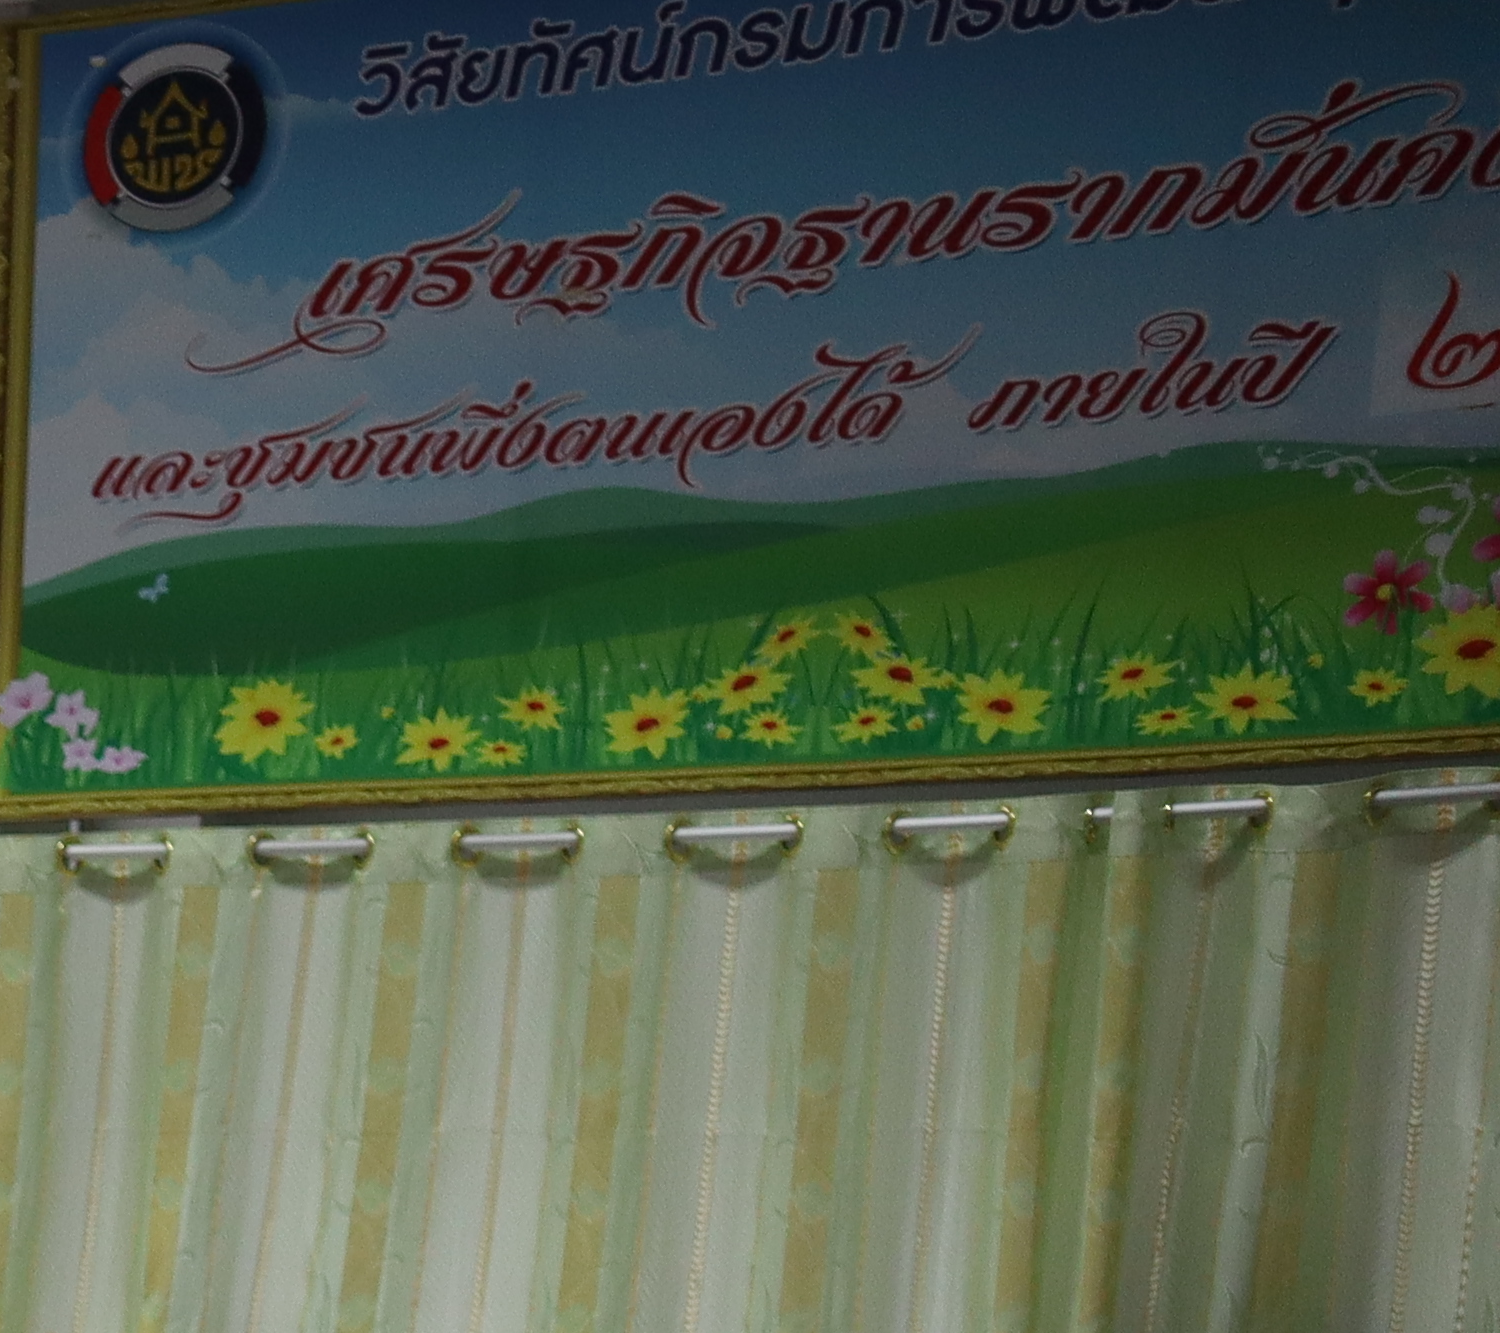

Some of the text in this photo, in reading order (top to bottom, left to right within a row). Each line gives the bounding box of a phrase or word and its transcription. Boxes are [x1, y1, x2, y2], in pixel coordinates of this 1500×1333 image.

[90, 322, 984, 530] และชุมชนพึ่งตนเองได้
[965, 310, 1338, 433] ภายในปี
